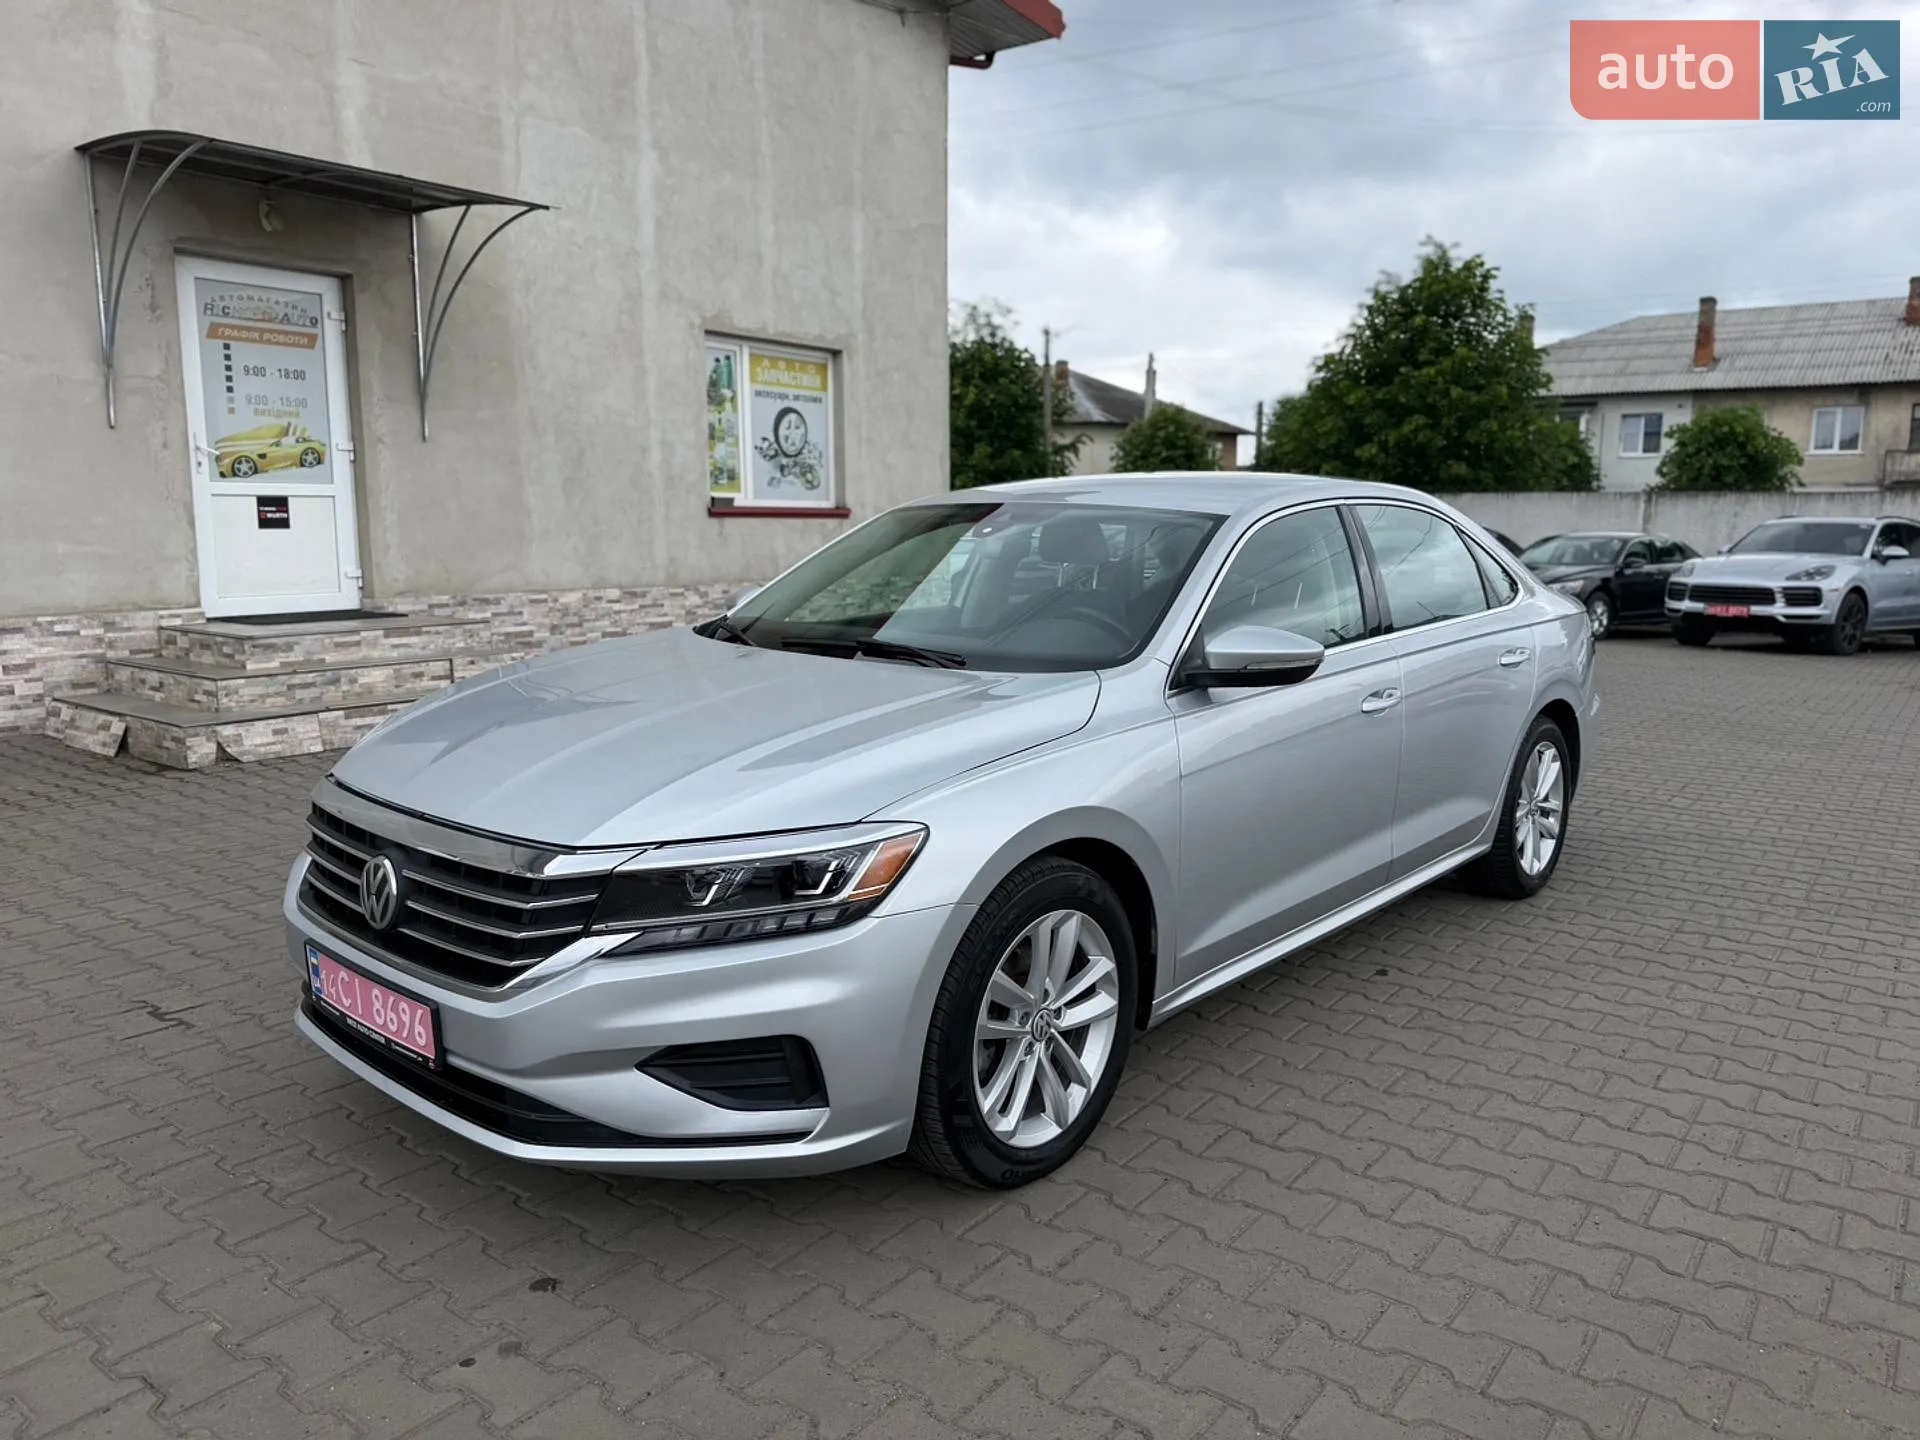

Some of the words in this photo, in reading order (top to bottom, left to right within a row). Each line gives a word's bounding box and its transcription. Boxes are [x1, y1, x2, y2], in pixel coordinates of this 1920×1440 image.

[217, 326, 261, 340] ГРАФІК
[262, 332, 309, 346] РОБОТИ
[243, 364, 267, 378] 9:00
[277, 368, 307, 381] 18:00
[371, 987, 427, 1047] 8696
